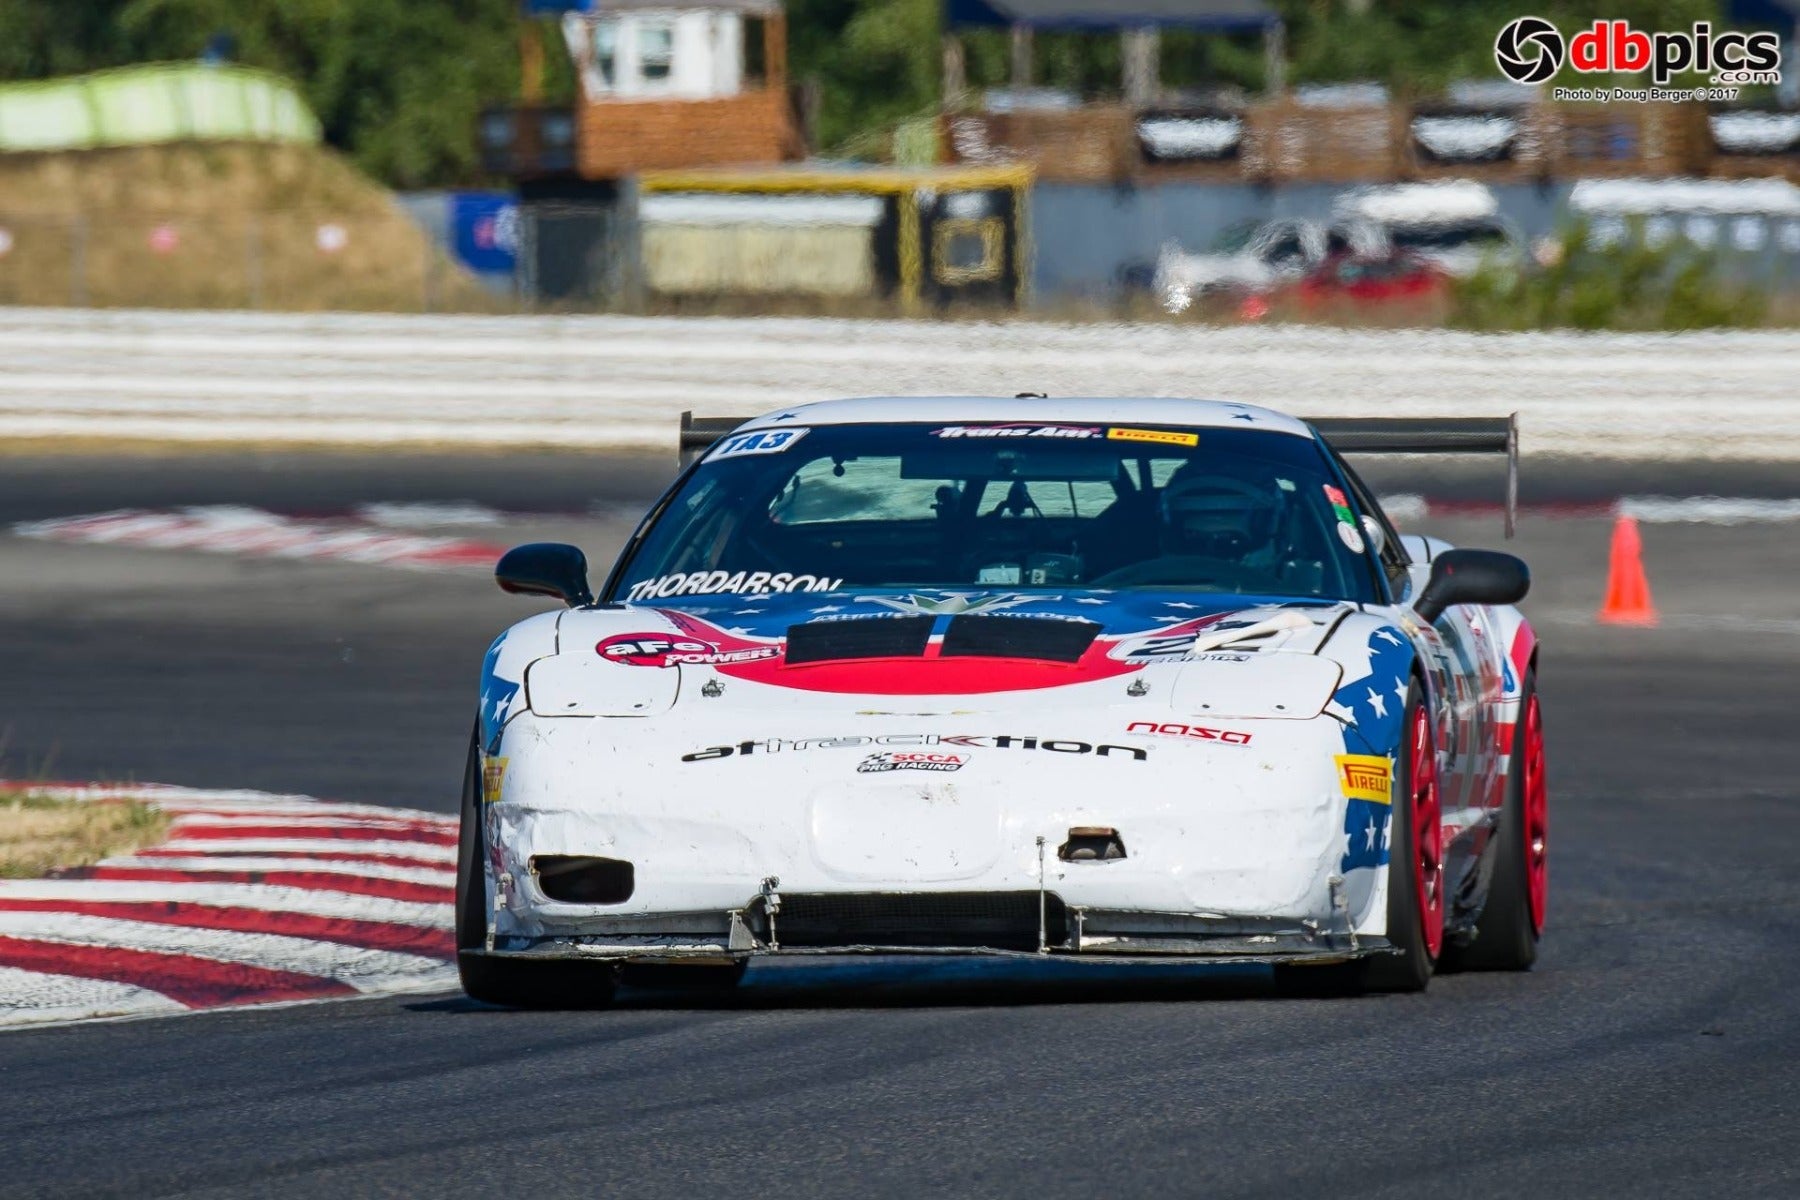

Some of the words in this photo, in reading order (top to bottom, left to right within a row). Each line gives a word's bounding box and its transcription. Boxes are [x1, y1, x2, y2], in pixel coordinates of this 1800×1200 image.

[939, 426, 1031, 439] Trans
[1029, 427, 1094, 439] Am
[720, 432, 794, 454] TA3
[627, 571, 844, 603] THORDARSON
[605, 640, 705, 656] aFe
[664, 648, 773, 667] POWER
[892, 753, 962, 763] SCCA
[858, 763, 894, 773] PRO
[896, 762, 959, 771] RACING
[1343, 763, 1388, 792] PIRELLI
